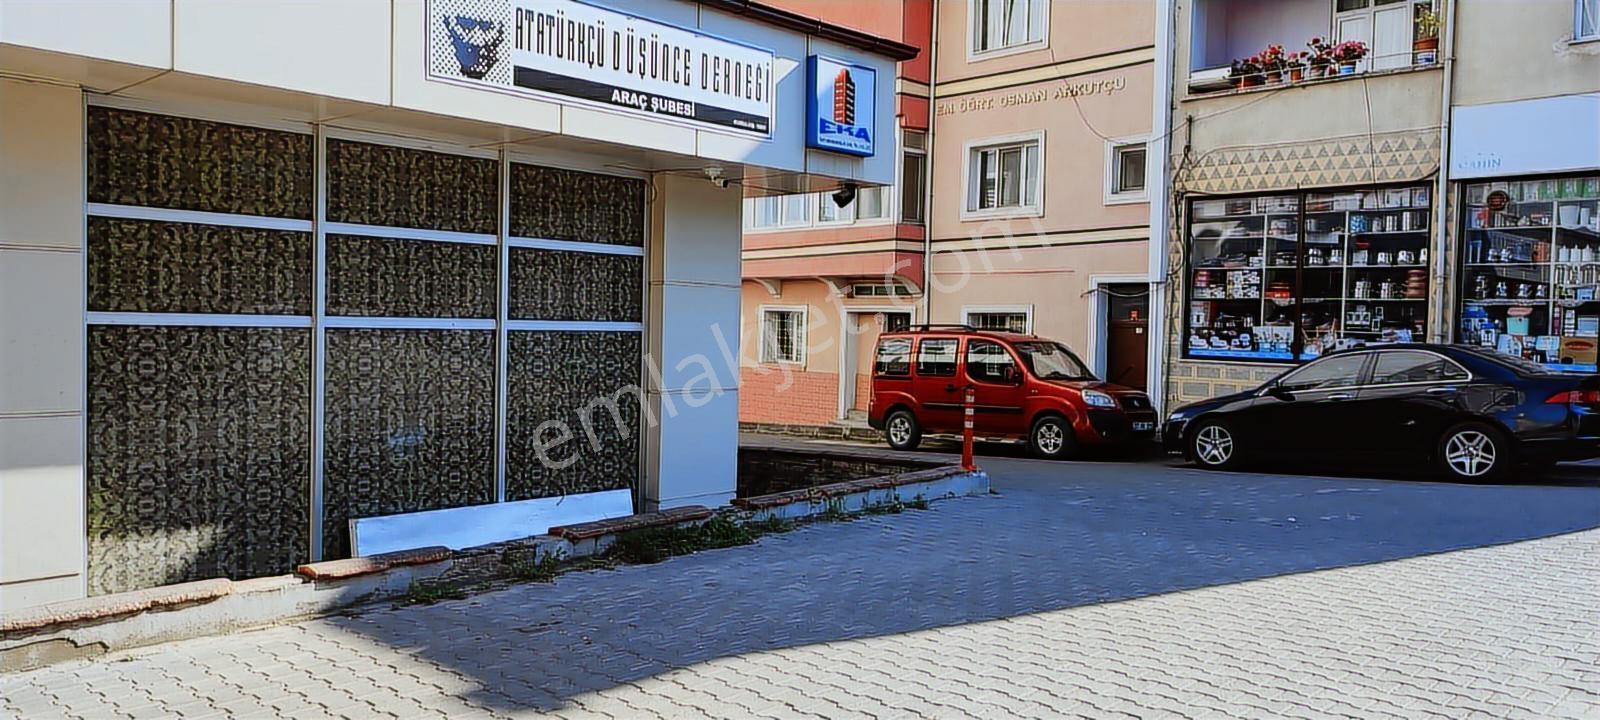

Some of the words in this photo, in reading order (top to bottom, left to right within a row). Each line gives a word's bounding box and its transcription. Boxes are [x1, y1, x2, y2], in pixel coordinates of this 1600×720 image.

[515, 7, 605, 69] ATATÜRKÇÜ
[613, 27, 691, 86] DÜŞÜNCE
[701, 52, 770, 103] DERNEĞİ
[611, 88, 648, 112] ARAÇ
[650, 96, 696, 118] ŞUBESİ
[1000, 88, 1048, 107] OSMAN
[1054, 75, 1126, 99] ARKUTÇU
[820, 117, 871, 143] EKA
